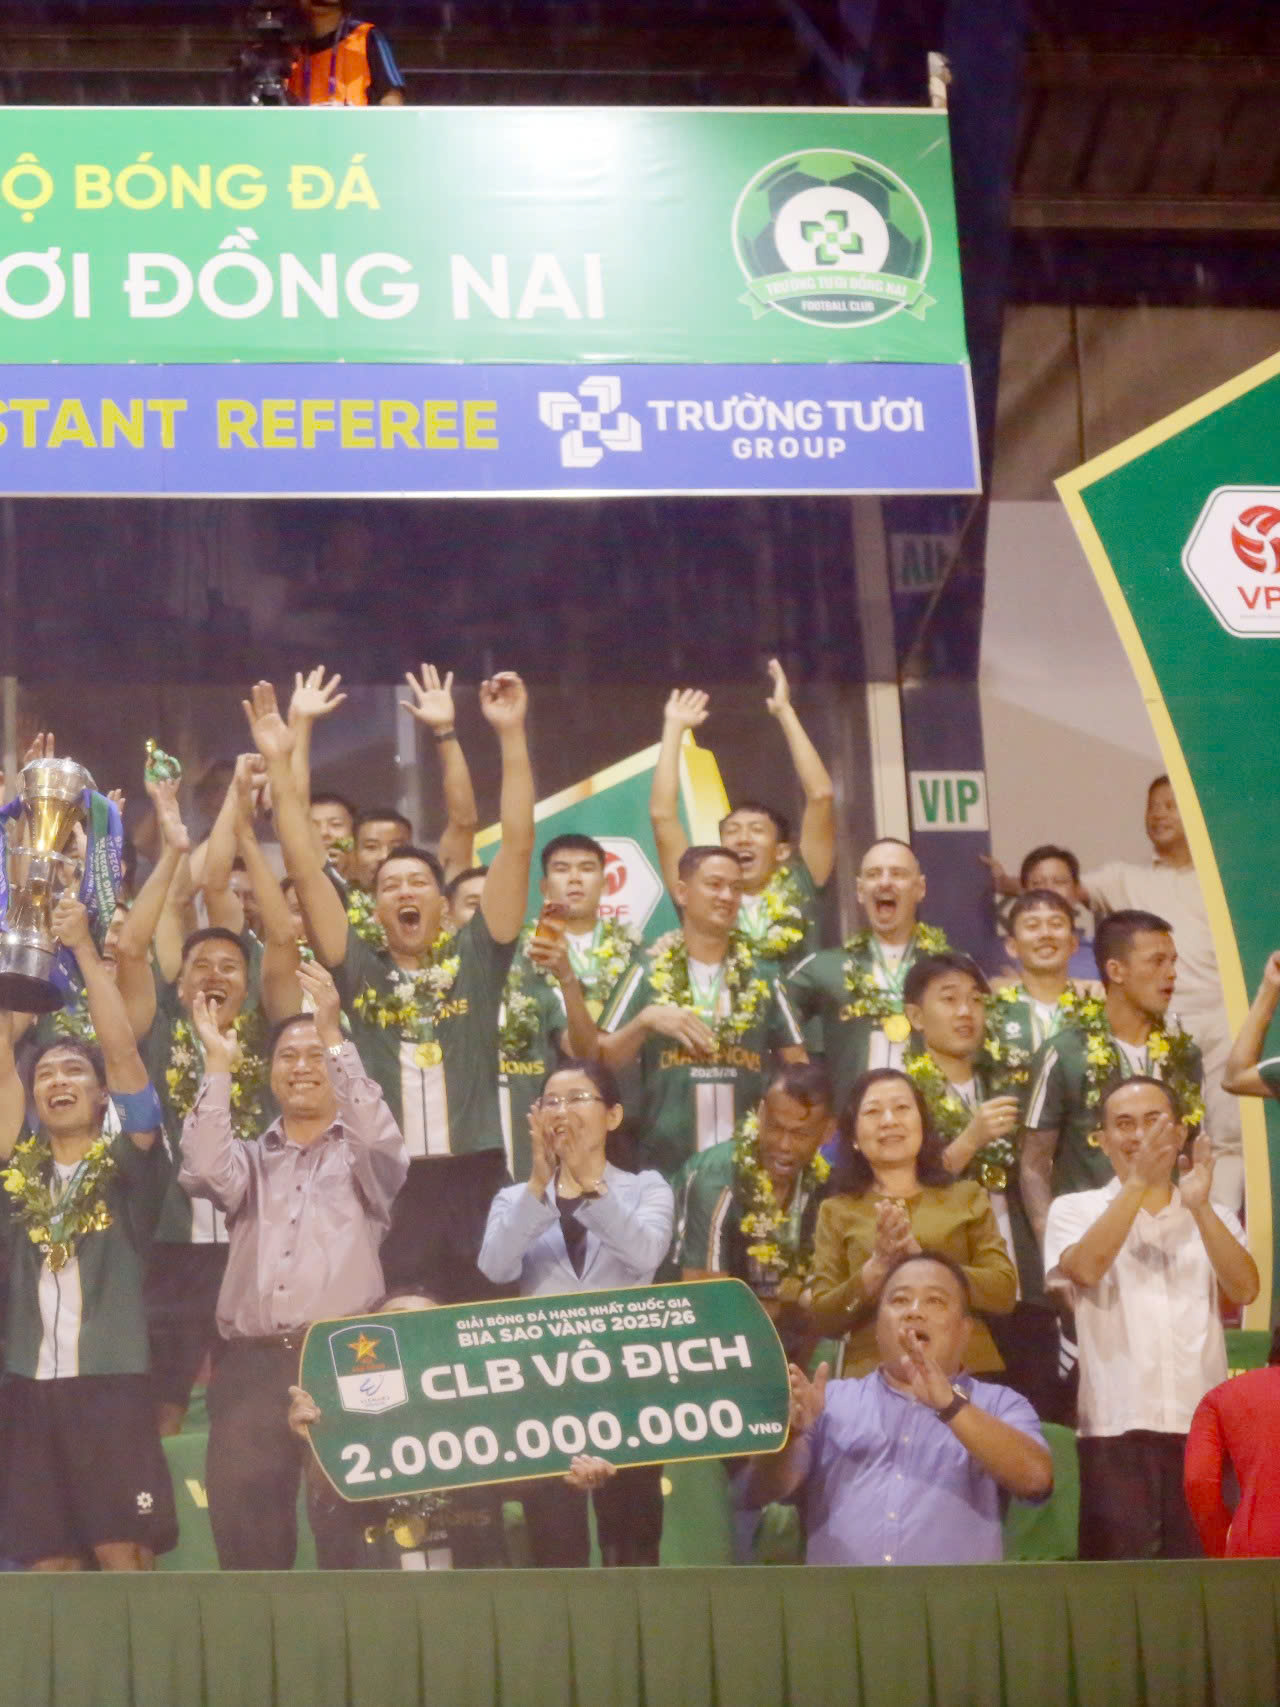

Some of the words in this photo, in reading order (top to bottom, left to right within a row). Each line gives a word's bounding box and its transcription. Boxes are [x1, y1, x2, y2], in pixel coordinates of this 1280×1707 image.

[75, 152, 268, 210] BÓNG
[287, 153, 381, 210] ĐÁ
[123, 227, 421, 320] ĐỒNG
[450, 253, 605, 321] NAI
[217, 399, 499, 450] REFEREE
[648, 393, 823, 433] TRƯỜNG
[826, 396, 924, 433] TƯƠI
[732, 436, 846, 459] GROUP
[1237, 586, 1280, 610] VP
[918, 779, 979, 823] VIP
[456, 1315, 483, 1330] GIẢI
[487, 1312, 524, 1326] BÓNG
[528, 1309, 547, 1322] ĐÁ
[549, 1305, 587, 1320] HẠNG
[589, 1303, 624, 1317] NHẤT
[627, 1296, 665, 1311] QUỐC
[668, 1297, 691, 1309] GIA
[458, 1330, 495, 1348] BIA
[499, 1325, 543, 1343] SAO
[547, 1315, 607, 1338] VÀNG
[611, 1309, 697, 1331] 2025/26
[420, 1357, 525, 1400] CLB
[531, 1338, 612, 1387] VÔ
[622, 1334, 752, 1384] ĐỊCH
[340, 1399, 744, 1484] 2.000.000.000
[748, 1422, 783, 1436] VNĐ
